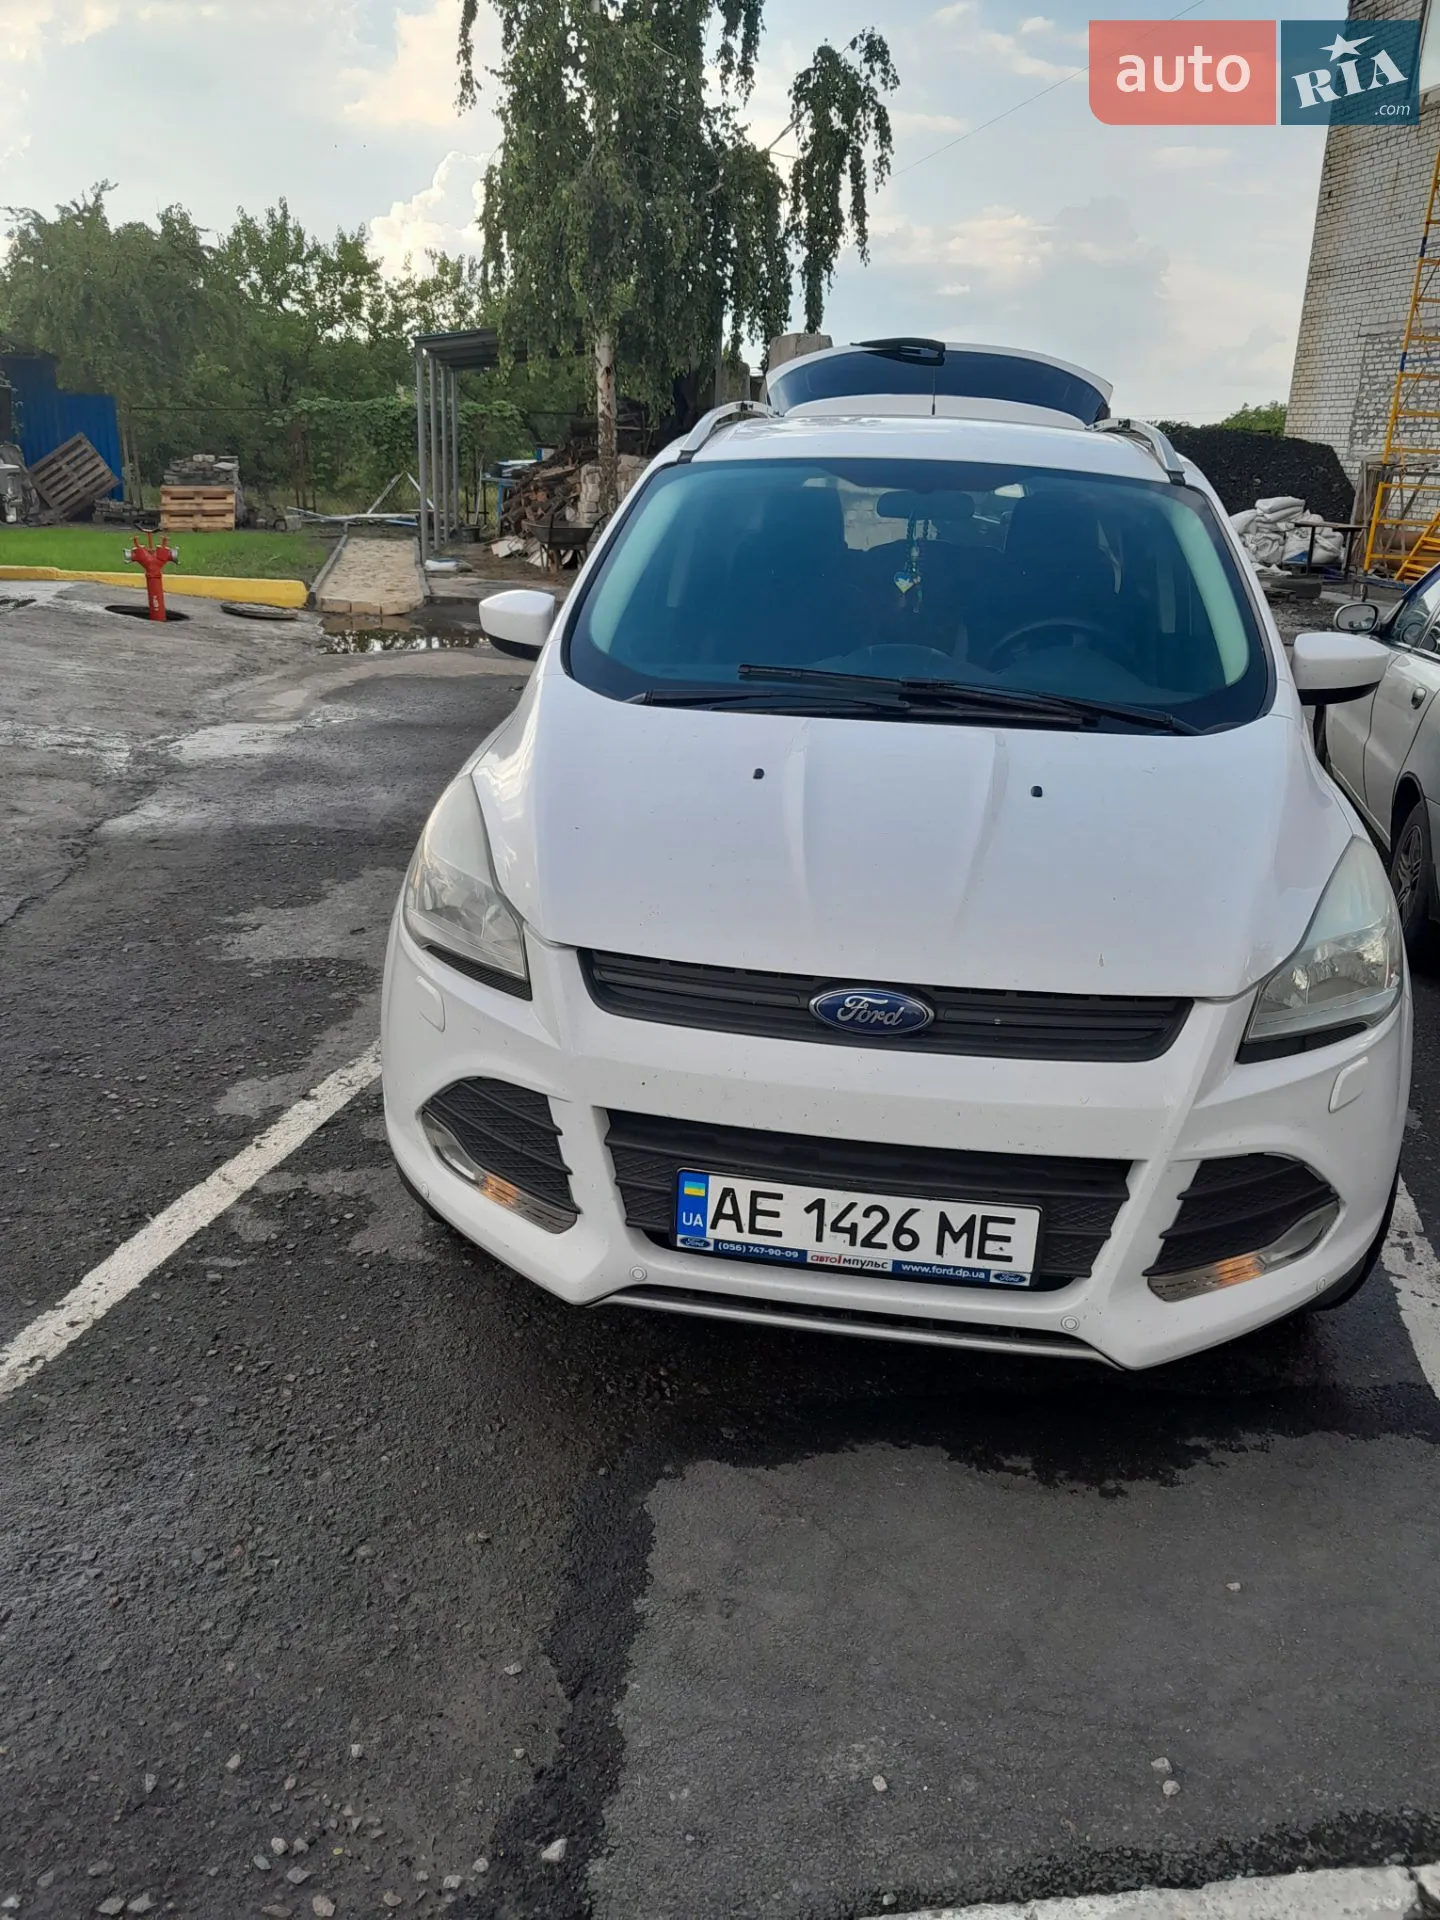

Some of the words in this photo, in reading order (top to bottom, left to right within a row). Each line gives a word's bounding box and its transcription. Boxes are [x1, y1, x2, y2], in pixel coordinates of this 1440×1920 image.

[836, 995, 905, 1026] Ford
[682, 1212, 703, 1228] UA
[709, 1187, 783, 1237] AE
[803, 1198, 920, 1252] 1426
[936, 1211, 1016, 1263] ME
[718, 1241, 746, 1254] (056)
[749, 1246, 799, 1259] 747-90-09
[901, 1262, 985, 1280] www.ford.dp.ua
[999, 1273, 1020, 1283] Ford
